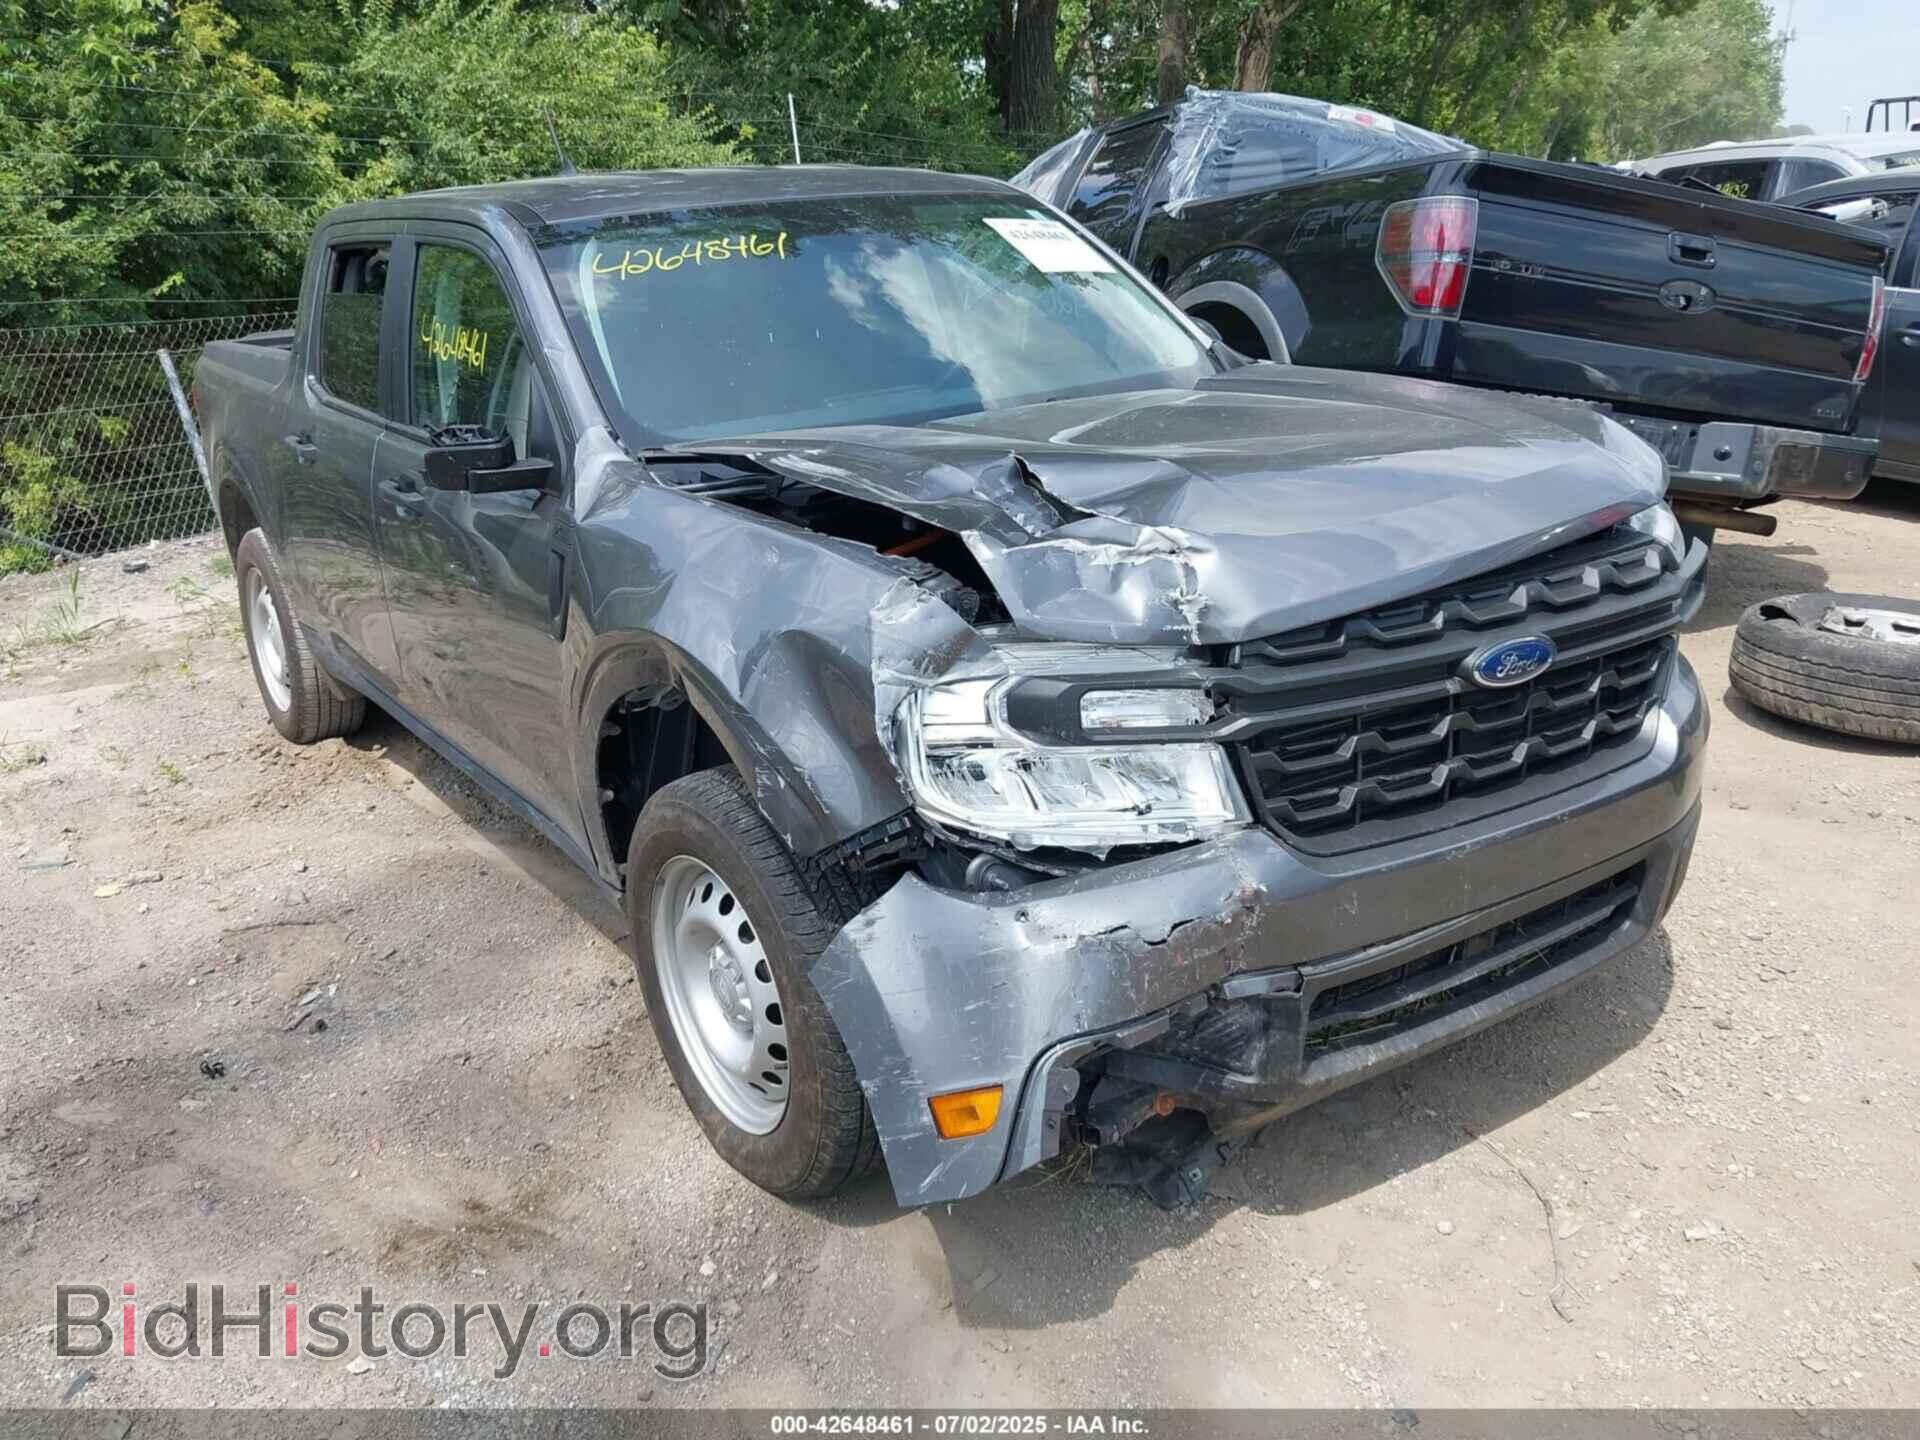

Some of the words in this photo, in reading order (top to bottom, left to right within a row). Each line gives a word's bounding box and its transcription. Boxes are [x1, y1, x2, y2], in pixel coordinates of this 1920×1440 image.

[592, 231, 787, 281] 42648461
[421, 314, 488, 376] 42648461
[1496, 650, 1541, 678] Ford
